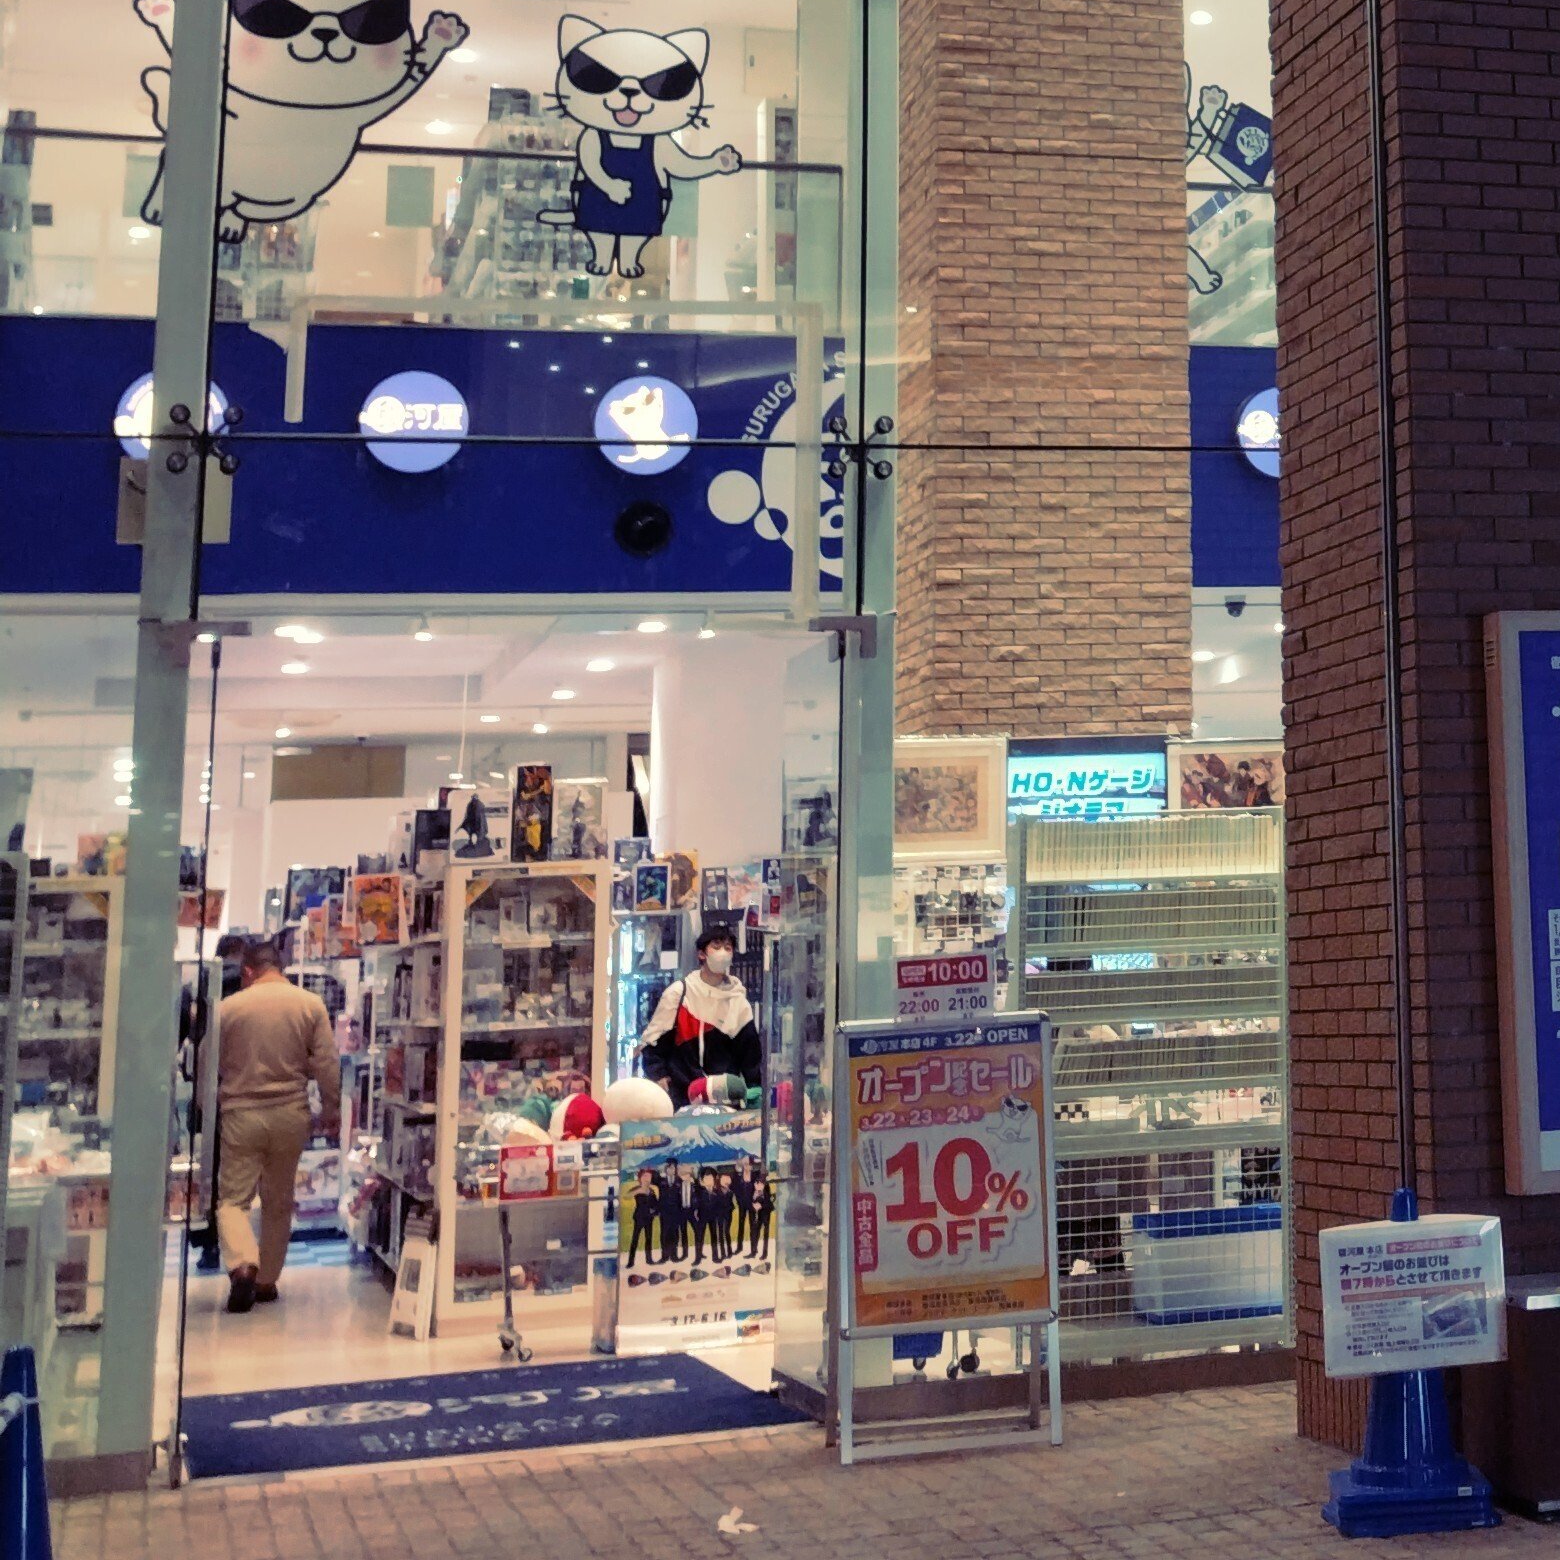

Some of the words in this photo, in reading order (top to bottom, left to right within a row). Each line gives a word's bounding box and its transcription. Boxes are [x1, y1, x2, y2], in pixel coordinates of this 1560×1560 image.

[928, 960, 983, 982] 10:00
[948, 995, 988, 1011] 21:00
[986, 1028, 1028, 1043] OPEN
[886, 1137, 1029, 1222] 10%
[907, 1215, 1009, 1260] OFF
